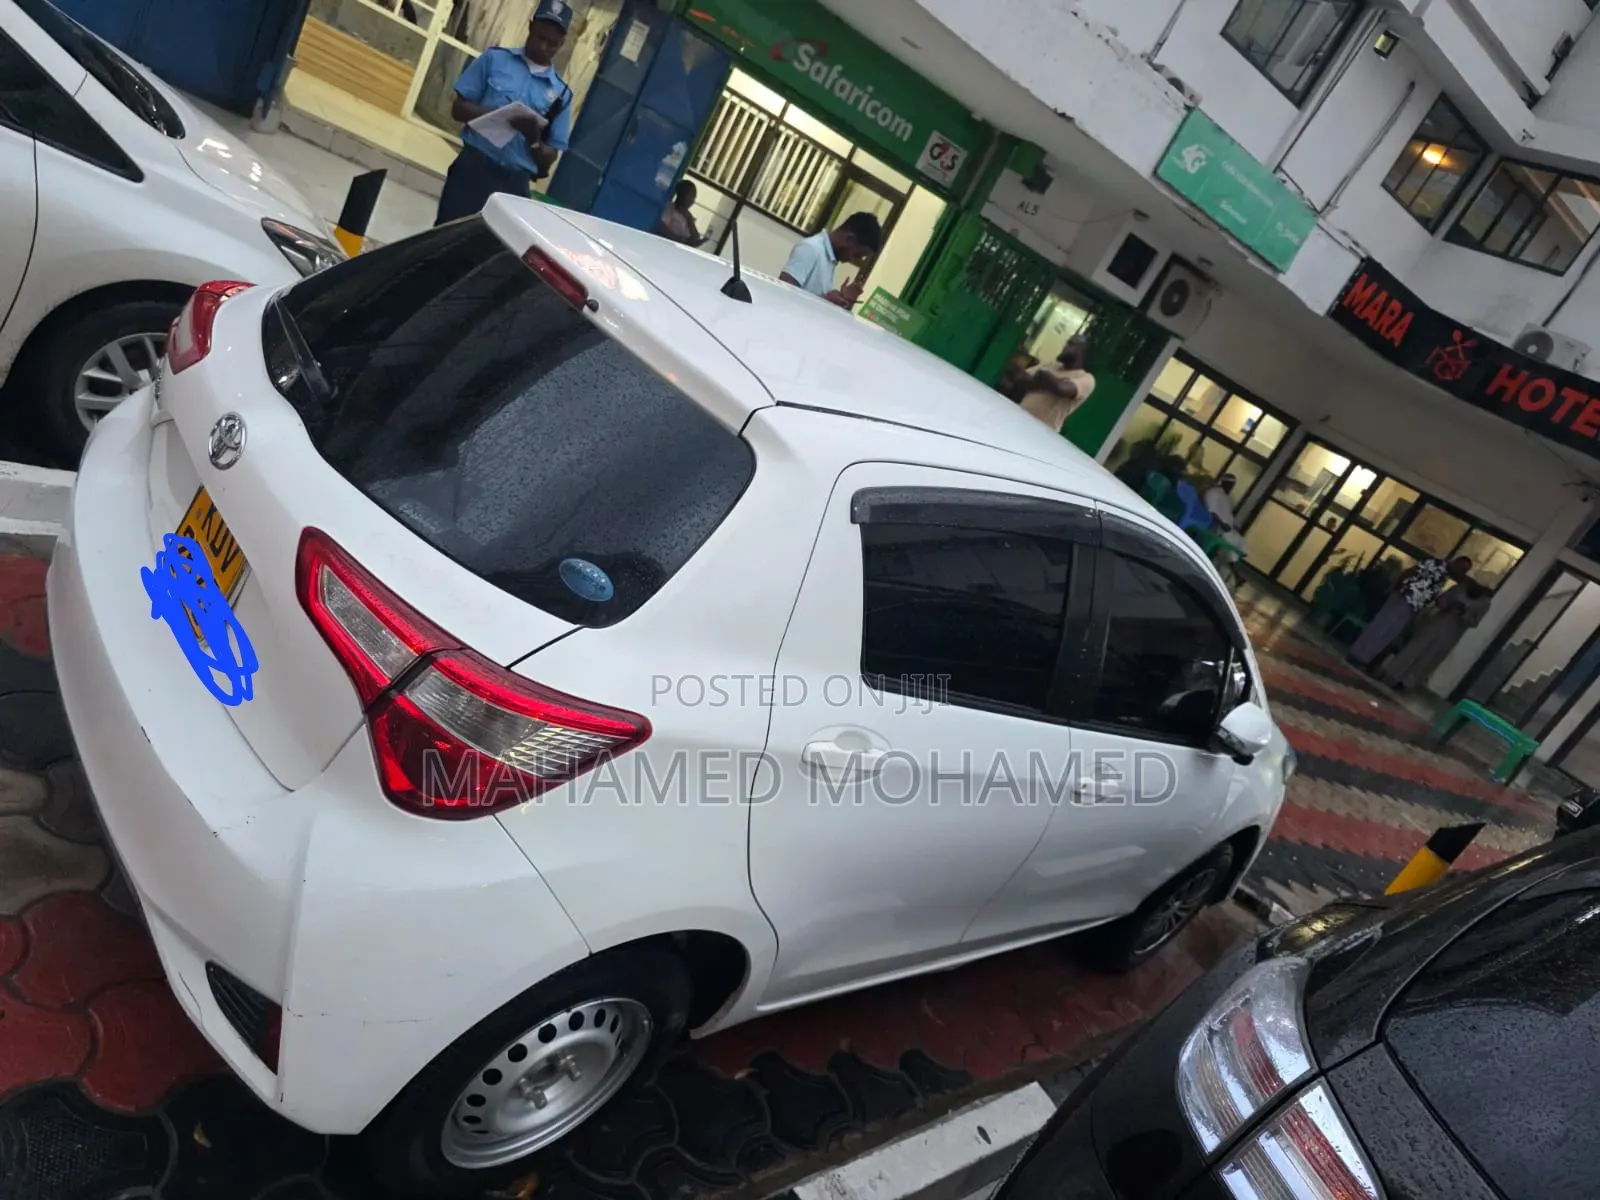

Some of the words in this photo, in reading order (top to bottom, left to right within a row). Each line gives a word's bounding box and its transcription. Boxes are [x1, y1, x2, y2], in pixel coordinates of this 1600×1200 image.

[793, 43, 913, 142] Safaricom
[1343, 272, 1414, 348] MARA
[1485, 363, 1600, 441] HOTE
